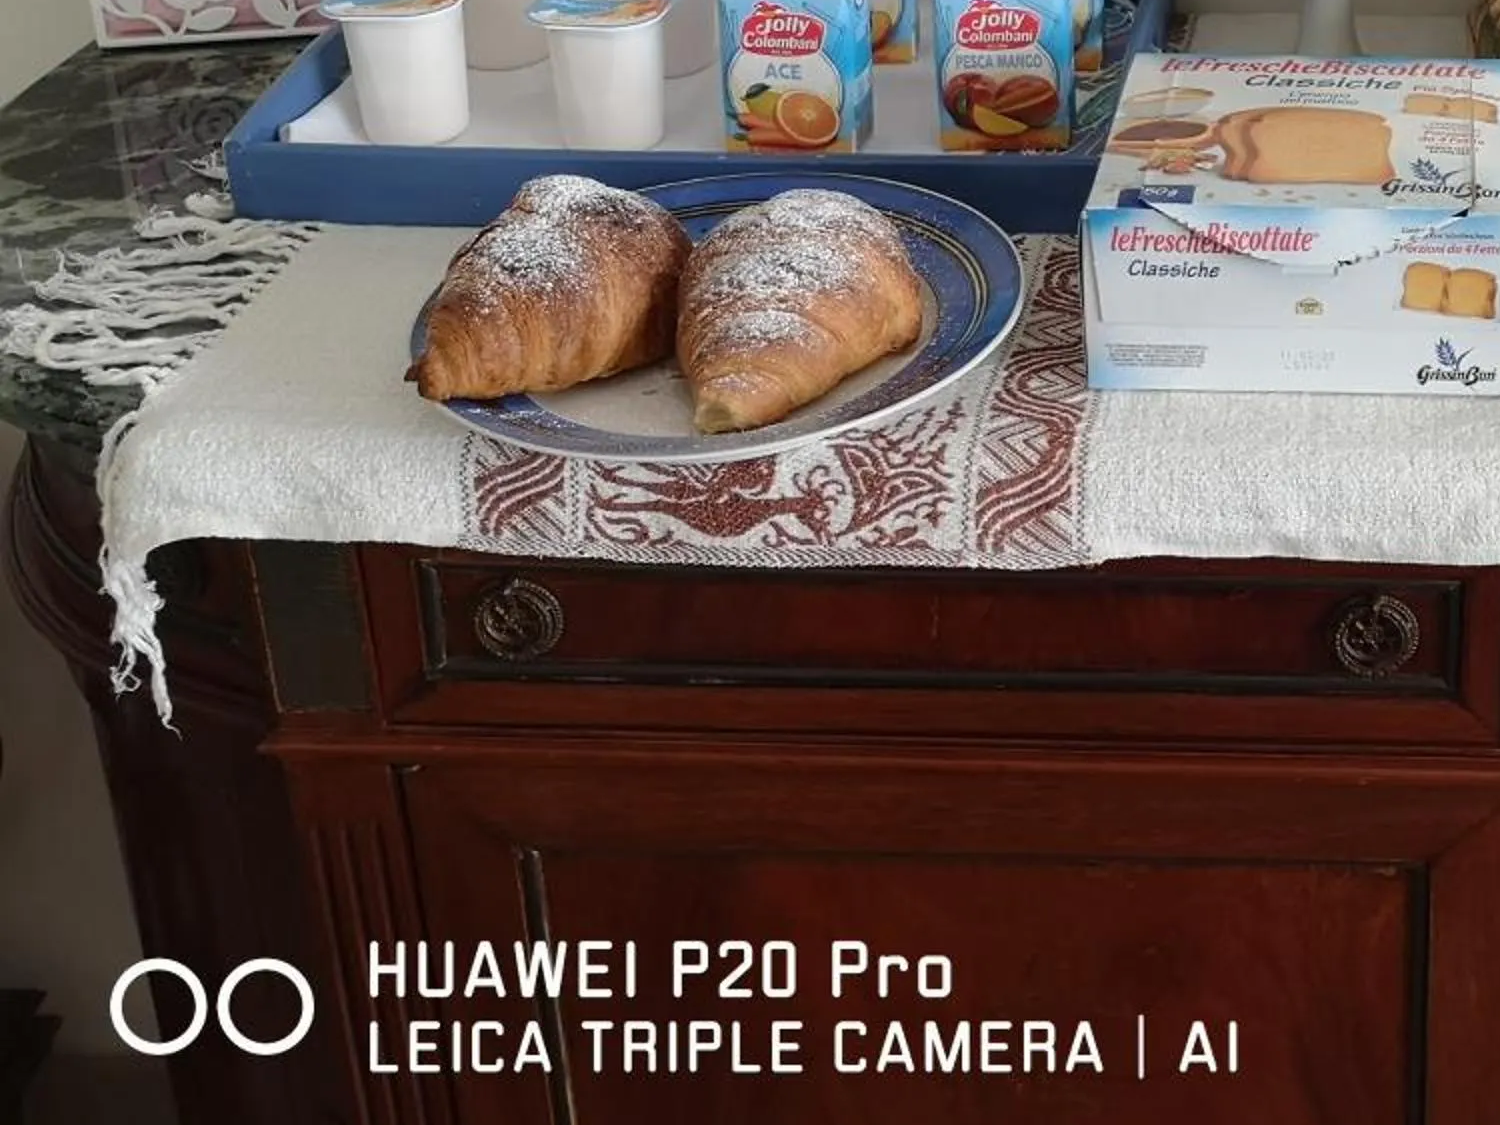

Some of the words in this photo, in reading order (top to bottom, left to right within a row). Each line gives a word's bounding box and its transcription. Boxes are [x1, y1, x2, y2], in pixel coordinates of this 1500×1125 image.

[755, 17, 811, 37] Jolly
[971, 11, 1025, 29] Jolly
[743, 31, 818, 50] Colombani
[958, 27, 1033, 44] Colombani
[955, 55, 993, 69] PESCA
[997, 55, 1043, 69] MANGO
[764, 63, 802, 79] ACE
[1245, 74, 1403, 90] Classiche
[1128, 259, 1221, 278] Classiche
